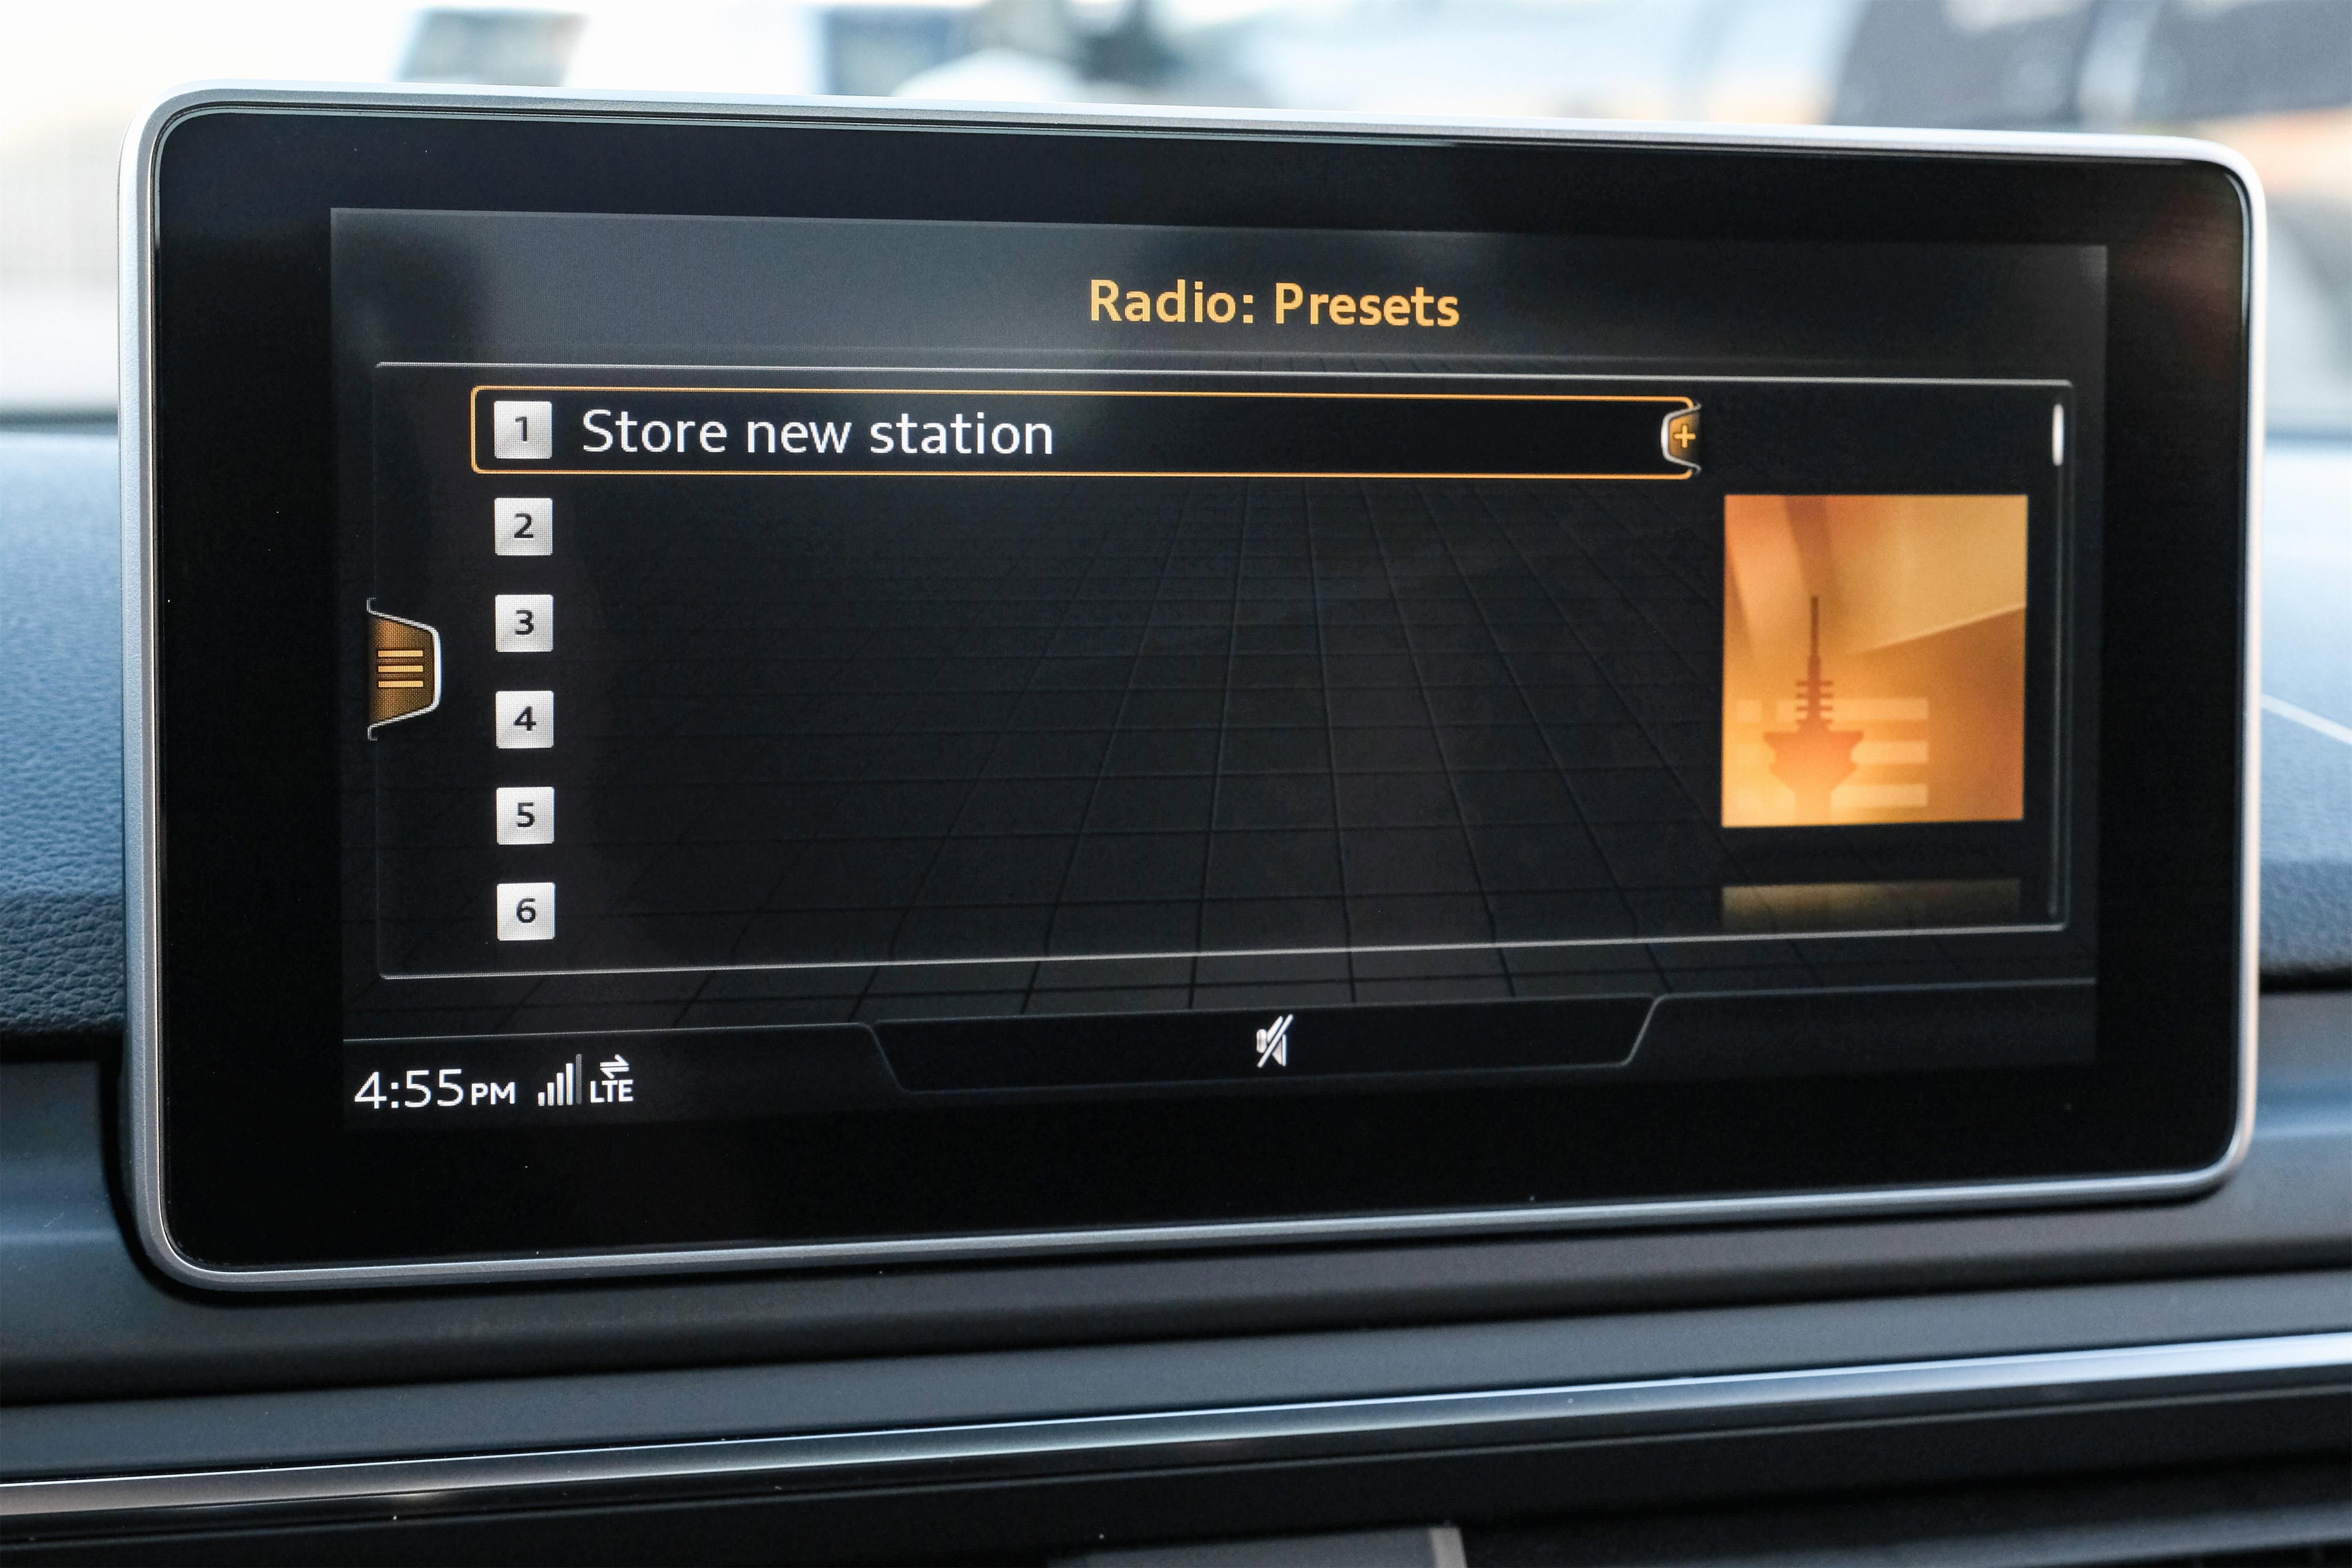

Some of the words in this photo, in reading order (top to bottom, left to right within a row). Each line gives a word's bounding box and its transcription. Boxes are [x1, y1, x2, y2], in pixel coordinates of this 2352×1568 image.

[1090, 279, 1254, 324] Radio:
[1275, 282, 1460, 327] Presets
[515, 416, 529, 442] 1
[582, 409, 728, 453] Store
[747, 421, 853, 454] new
[870, 411, 1054, 455] station
[513, 512, 534, 539] 2
[514, 609, 535, 636] 3
[512, 706, 537, 732] 4
[516, 802, 536, 828] 5
[516, 898, 537, 924] 6
[589, 1079, 635, 1104] LTE
